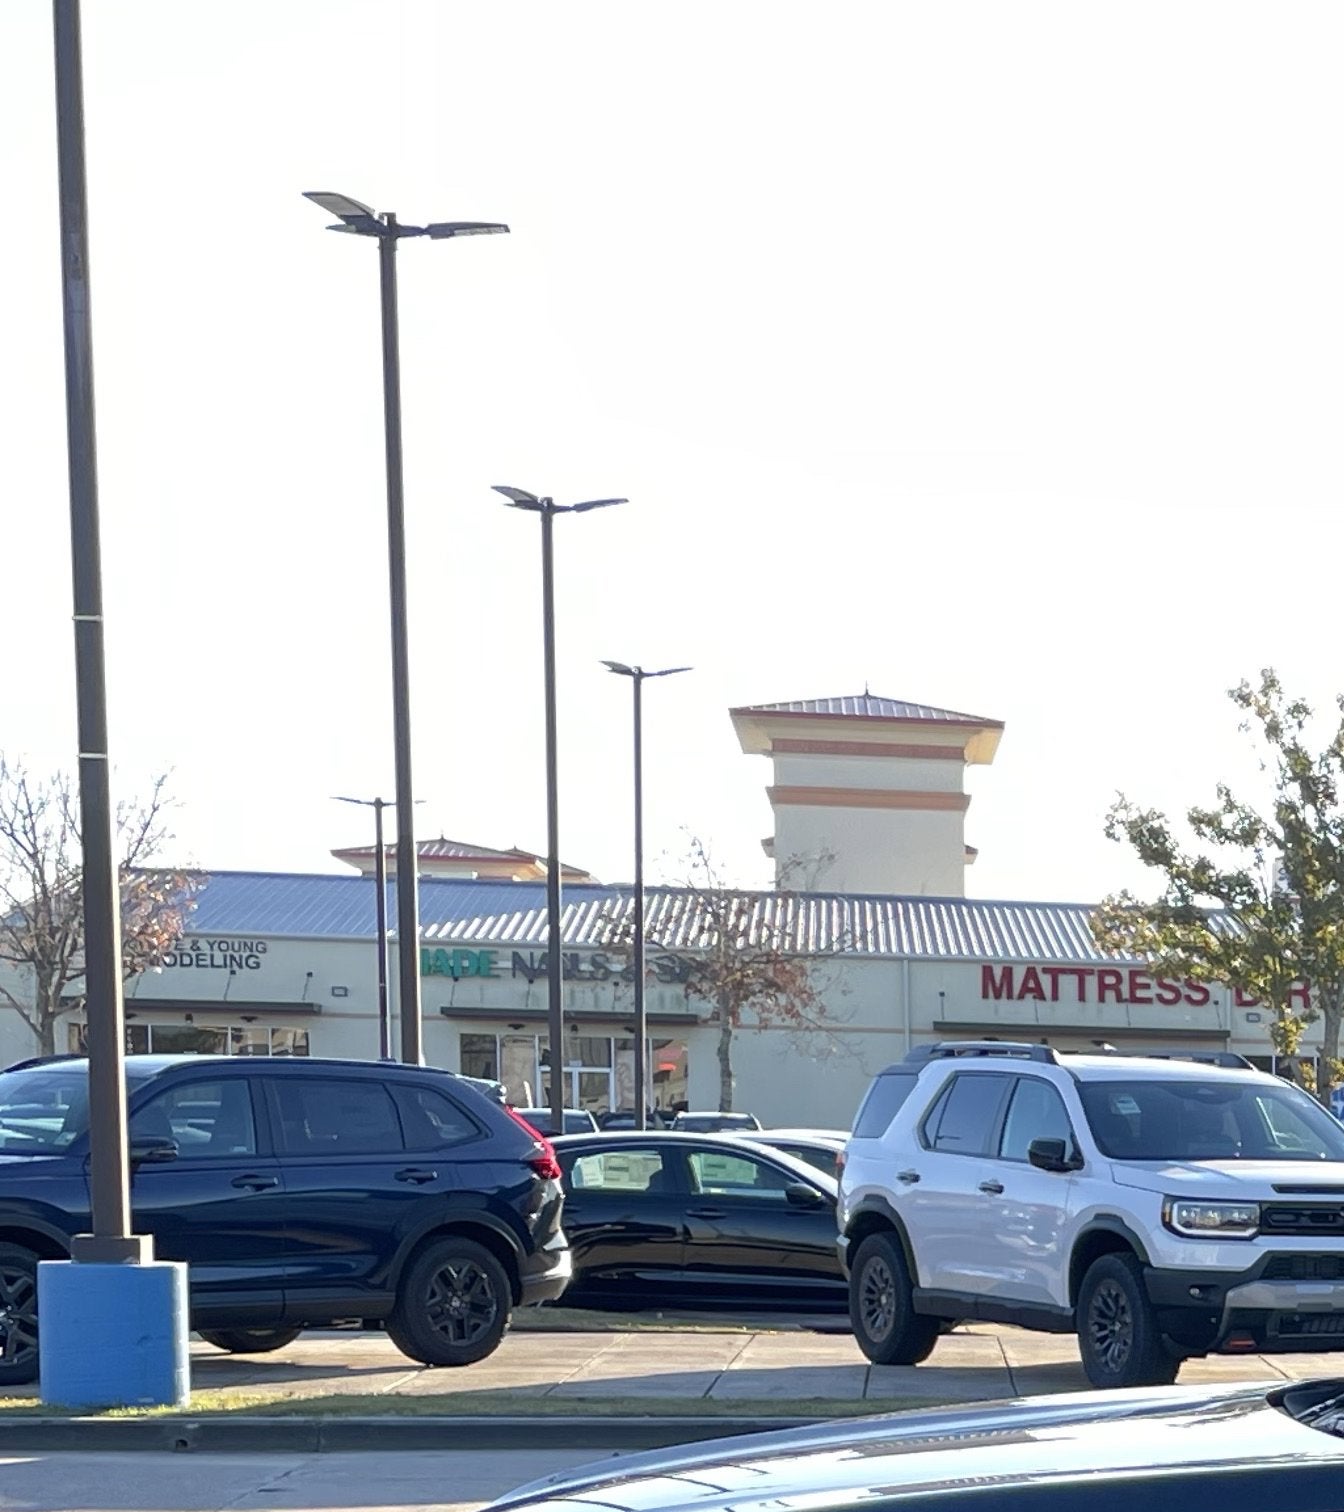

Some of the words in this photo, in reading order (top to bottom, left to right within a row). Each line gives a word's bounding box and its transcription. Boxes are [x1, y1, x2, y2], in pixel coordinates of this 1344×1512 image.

[206, 940, 267, 954] YOUNG
[154, 952, 261, 970] ODELING
[981, 964, 1210, 1007] MATTRESS
